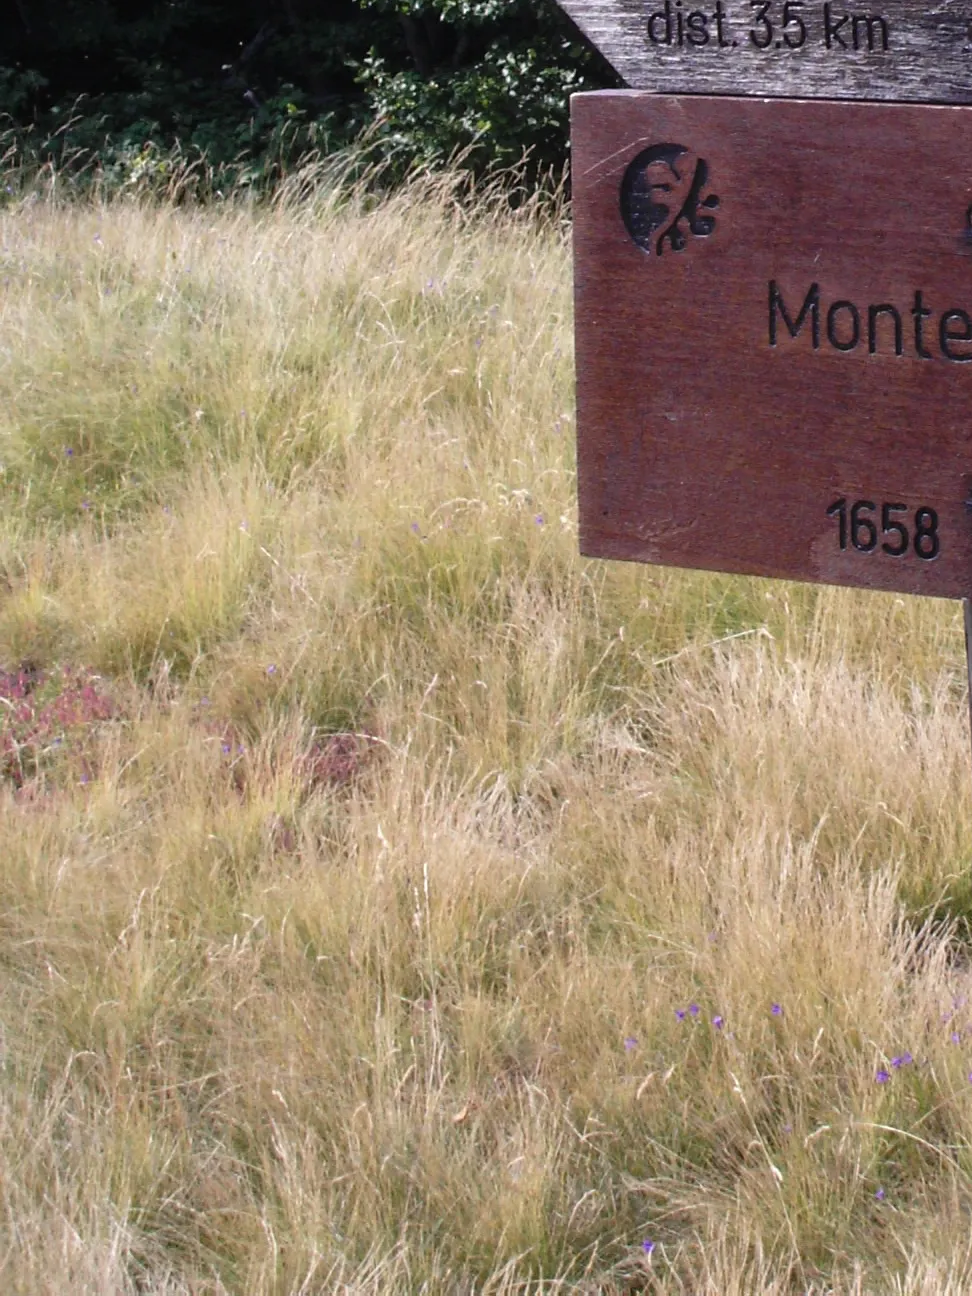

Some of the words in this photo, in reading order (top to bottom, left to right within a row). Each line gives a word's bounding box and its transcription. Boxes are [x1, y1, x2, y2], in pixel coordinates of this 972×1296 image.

[647, 0, 739, 48] dist.
[823, 2, 889, 51] km
[826, 497, 940, 561] 1658
